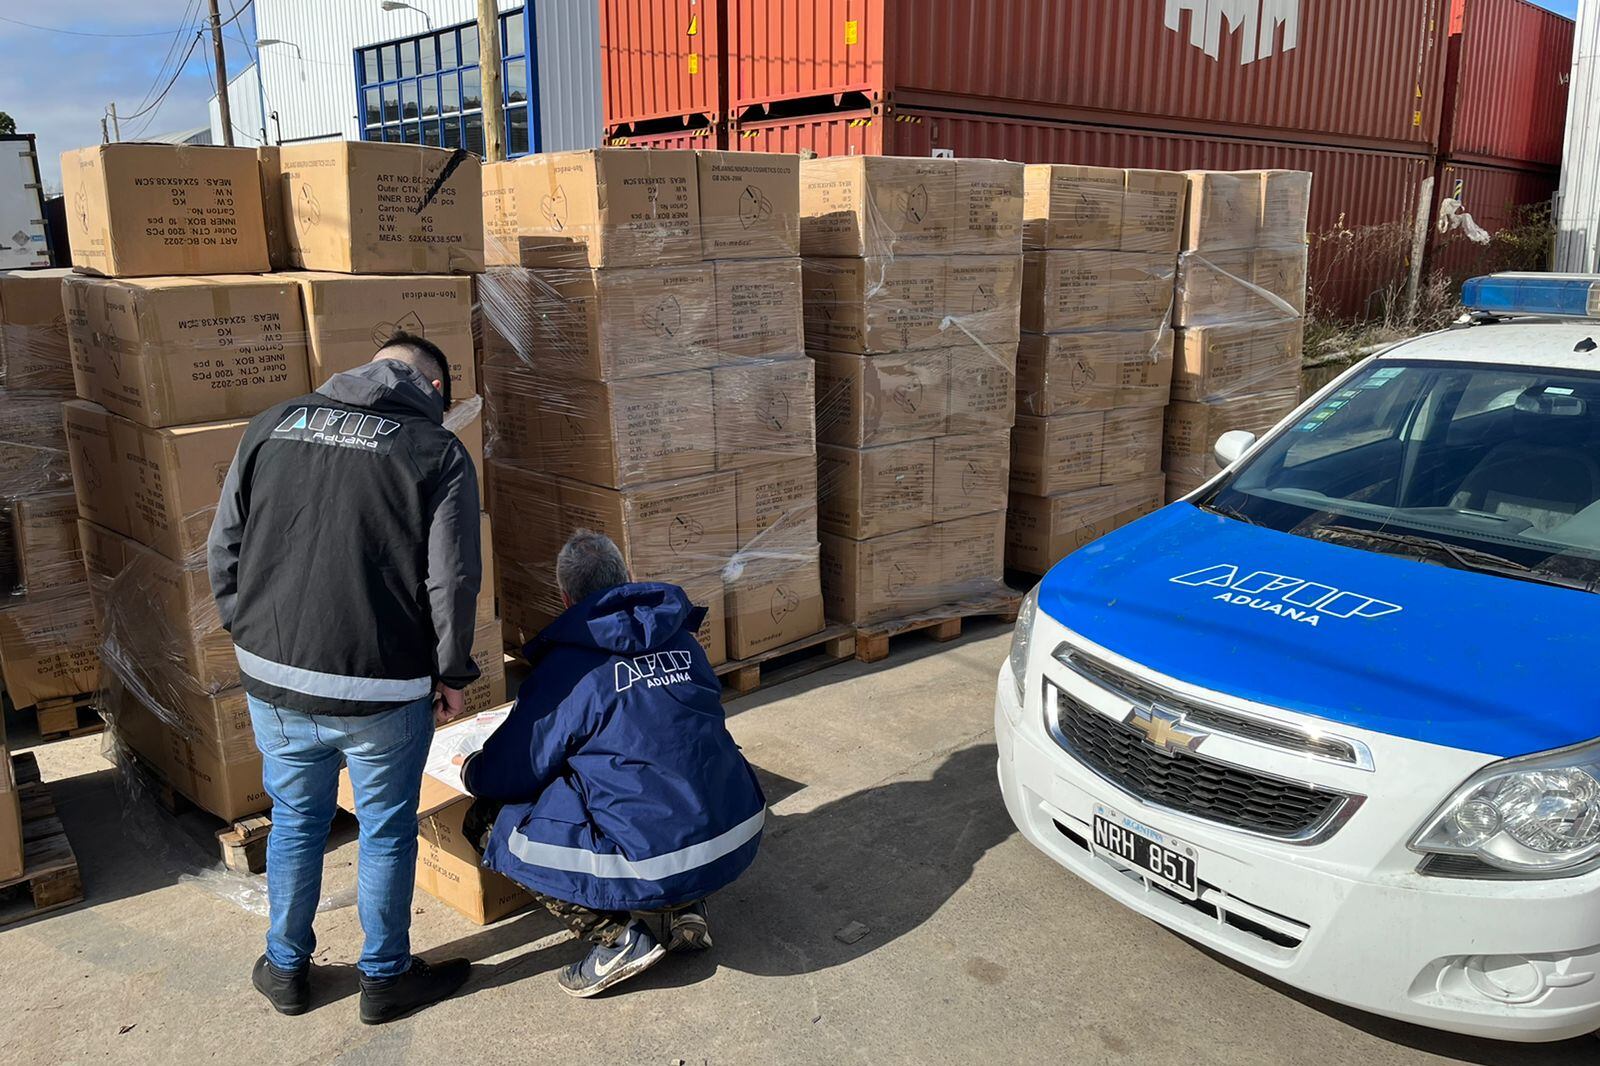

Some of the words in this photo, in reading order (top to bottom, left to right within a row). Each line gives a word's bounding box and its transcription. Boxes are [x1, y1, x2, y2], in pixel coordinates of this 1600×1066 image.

[203, 178, 232, 186] MEAS:
[171, 188, 185, 196] KG
[377, 185, 399, 193] Outer
[441, 188, 456, 196] PCS
[172, 198, 186, 206] KG
[378, 195, 402, 203] INNER
[378, 205, 405, 213] Carton
[146, 228, 165, 236] PCS
[421, 225, 433, 233] KG
[220, 237, 238, 245] ART
[379, 234, 405, 242] MEAS:
[401, 290, 457, 299] Non-medical
[217, 328, 232, 336] KG
[219, 337, 234, 346] KG
[254, 343, 284, 352] Carton
[259, 354, 285, 363] INNER
[193, 359, 210, 369] pcs
[263, 363, 286, 372] Outer
[192, 372, 212, 381] PCS
[215, 369, 233, 378] 1200
[269, 374, 287, 382] ART
[1169, 563, 1403, 618] AFIP
[1213, 592, 1320, 627] ADUANA
[615, 650, 692, 692] AFIP
[647, 672, 692, 688] ADUANA
[479, 699, 491, 708] ART
[1096, 817, 1135, 860] NRH
[1149, 843, 1191, 889] 851
